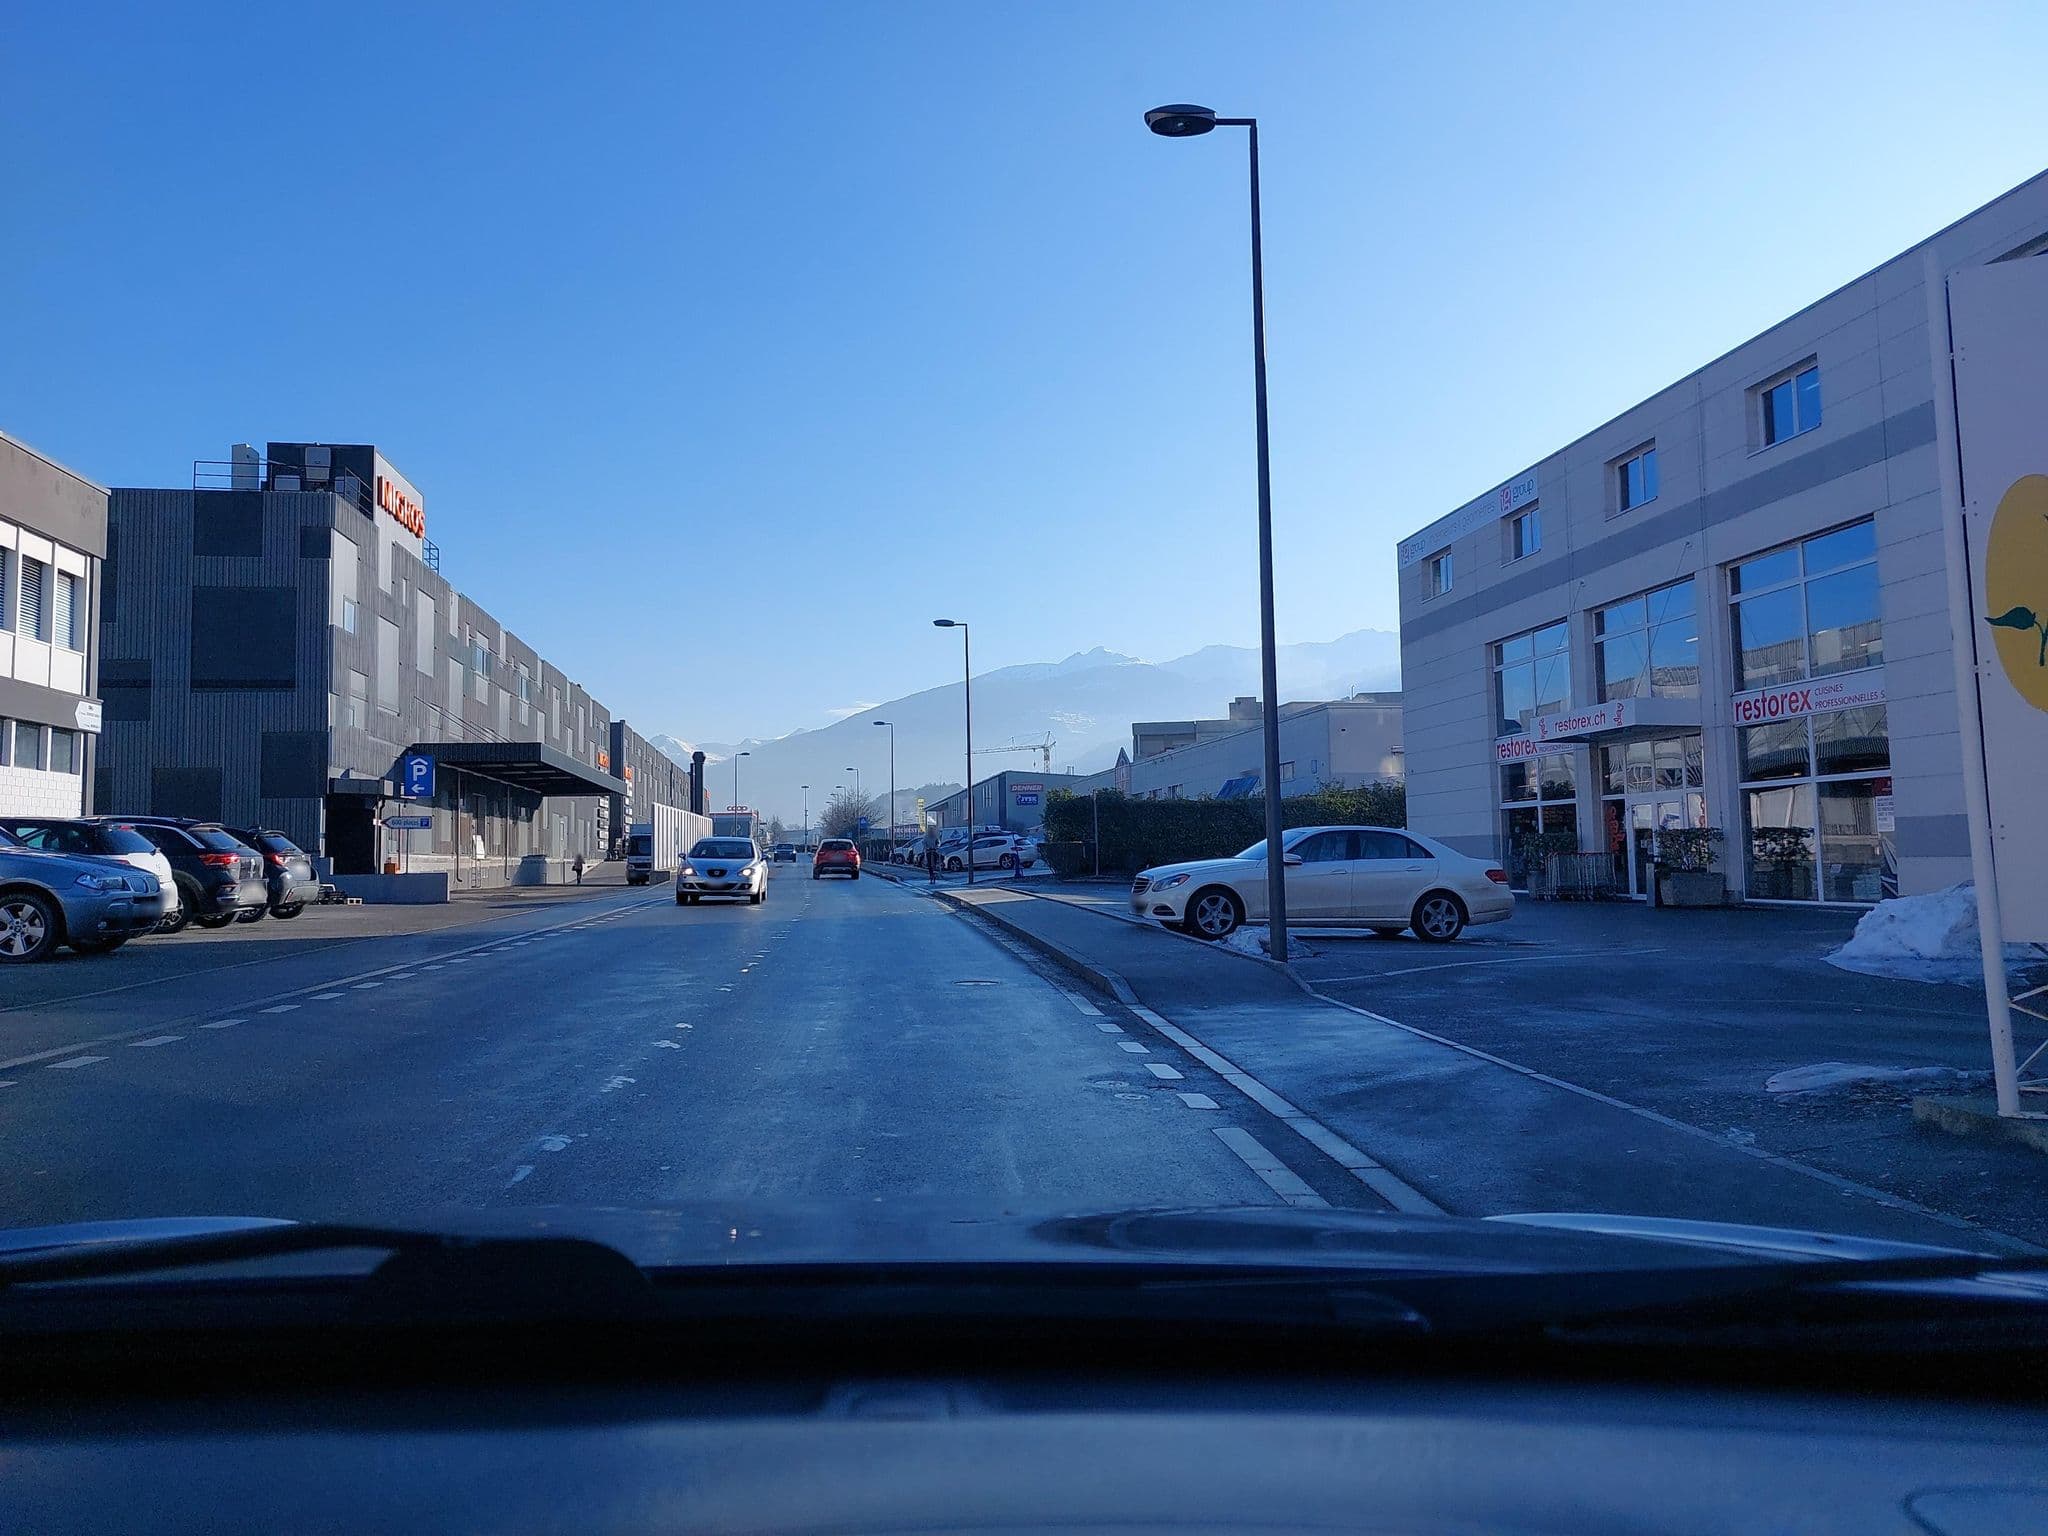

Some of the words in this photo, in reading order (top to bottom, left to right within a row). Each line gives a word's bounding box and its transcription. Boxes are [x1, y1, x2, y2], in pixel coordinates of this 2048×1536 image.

[1512, 479, 1535, 503] group
[377, 475, 426, 538] MIGROS
[1735, 689, 1812, 722] restorex
[1814, 683, 1844, 696] CUISINES
[1814, 691, 1879, 710] PROFESSIONNELLES
[1553, 710, 1606, 733] restorex.ch
[1496, 737, 1538, 760] restorex
[413, 765, 427, 781] P
